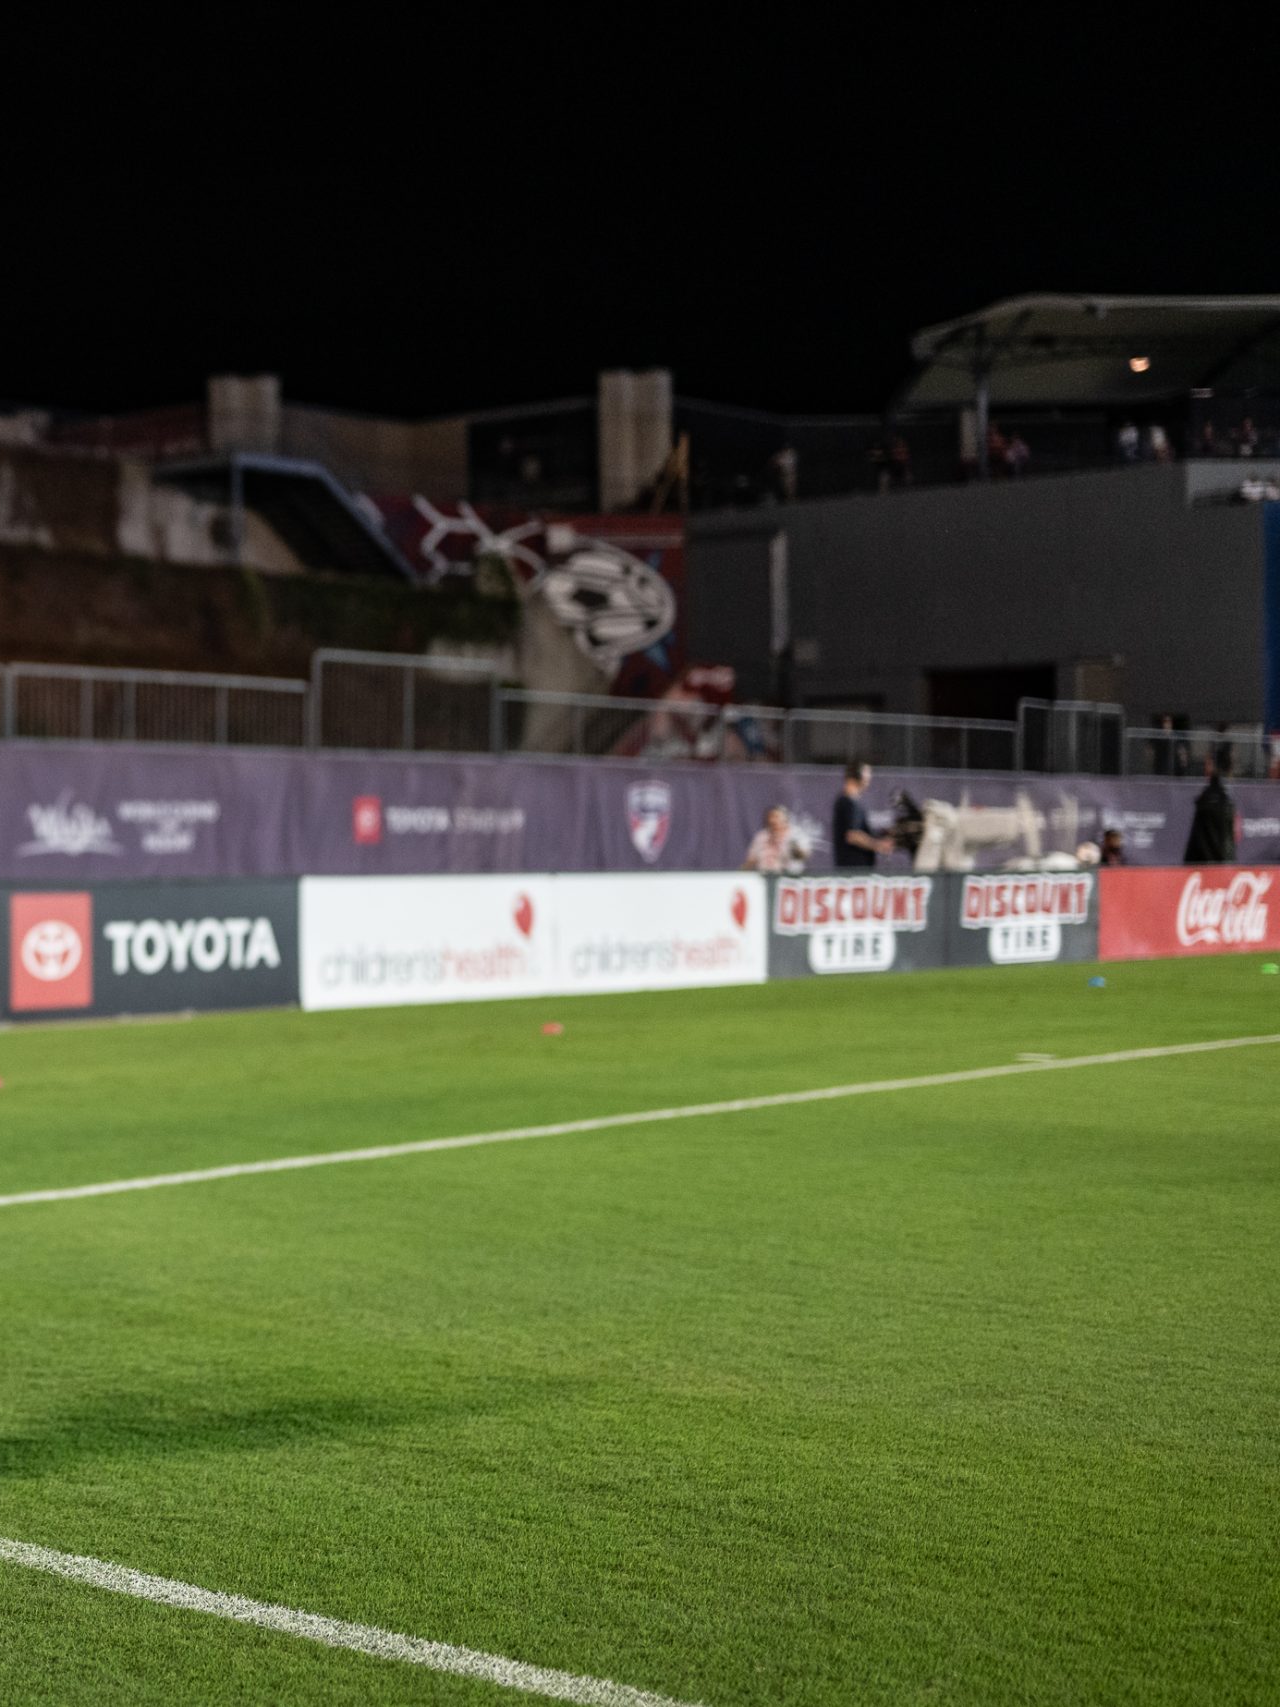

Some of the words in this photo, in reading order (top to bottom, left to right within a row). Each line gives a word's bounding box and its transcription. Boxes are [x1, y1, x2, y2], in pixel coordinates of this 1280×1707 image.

[778, 883, 926, 928] DISCOUNT
[964, 880, 1087, 921] DISCOUNT
[103, 917, 281, 974] TOYOTA
[823, 929, 882, 961] TIRE
[1001, 925, 1050, 950] TIRE
